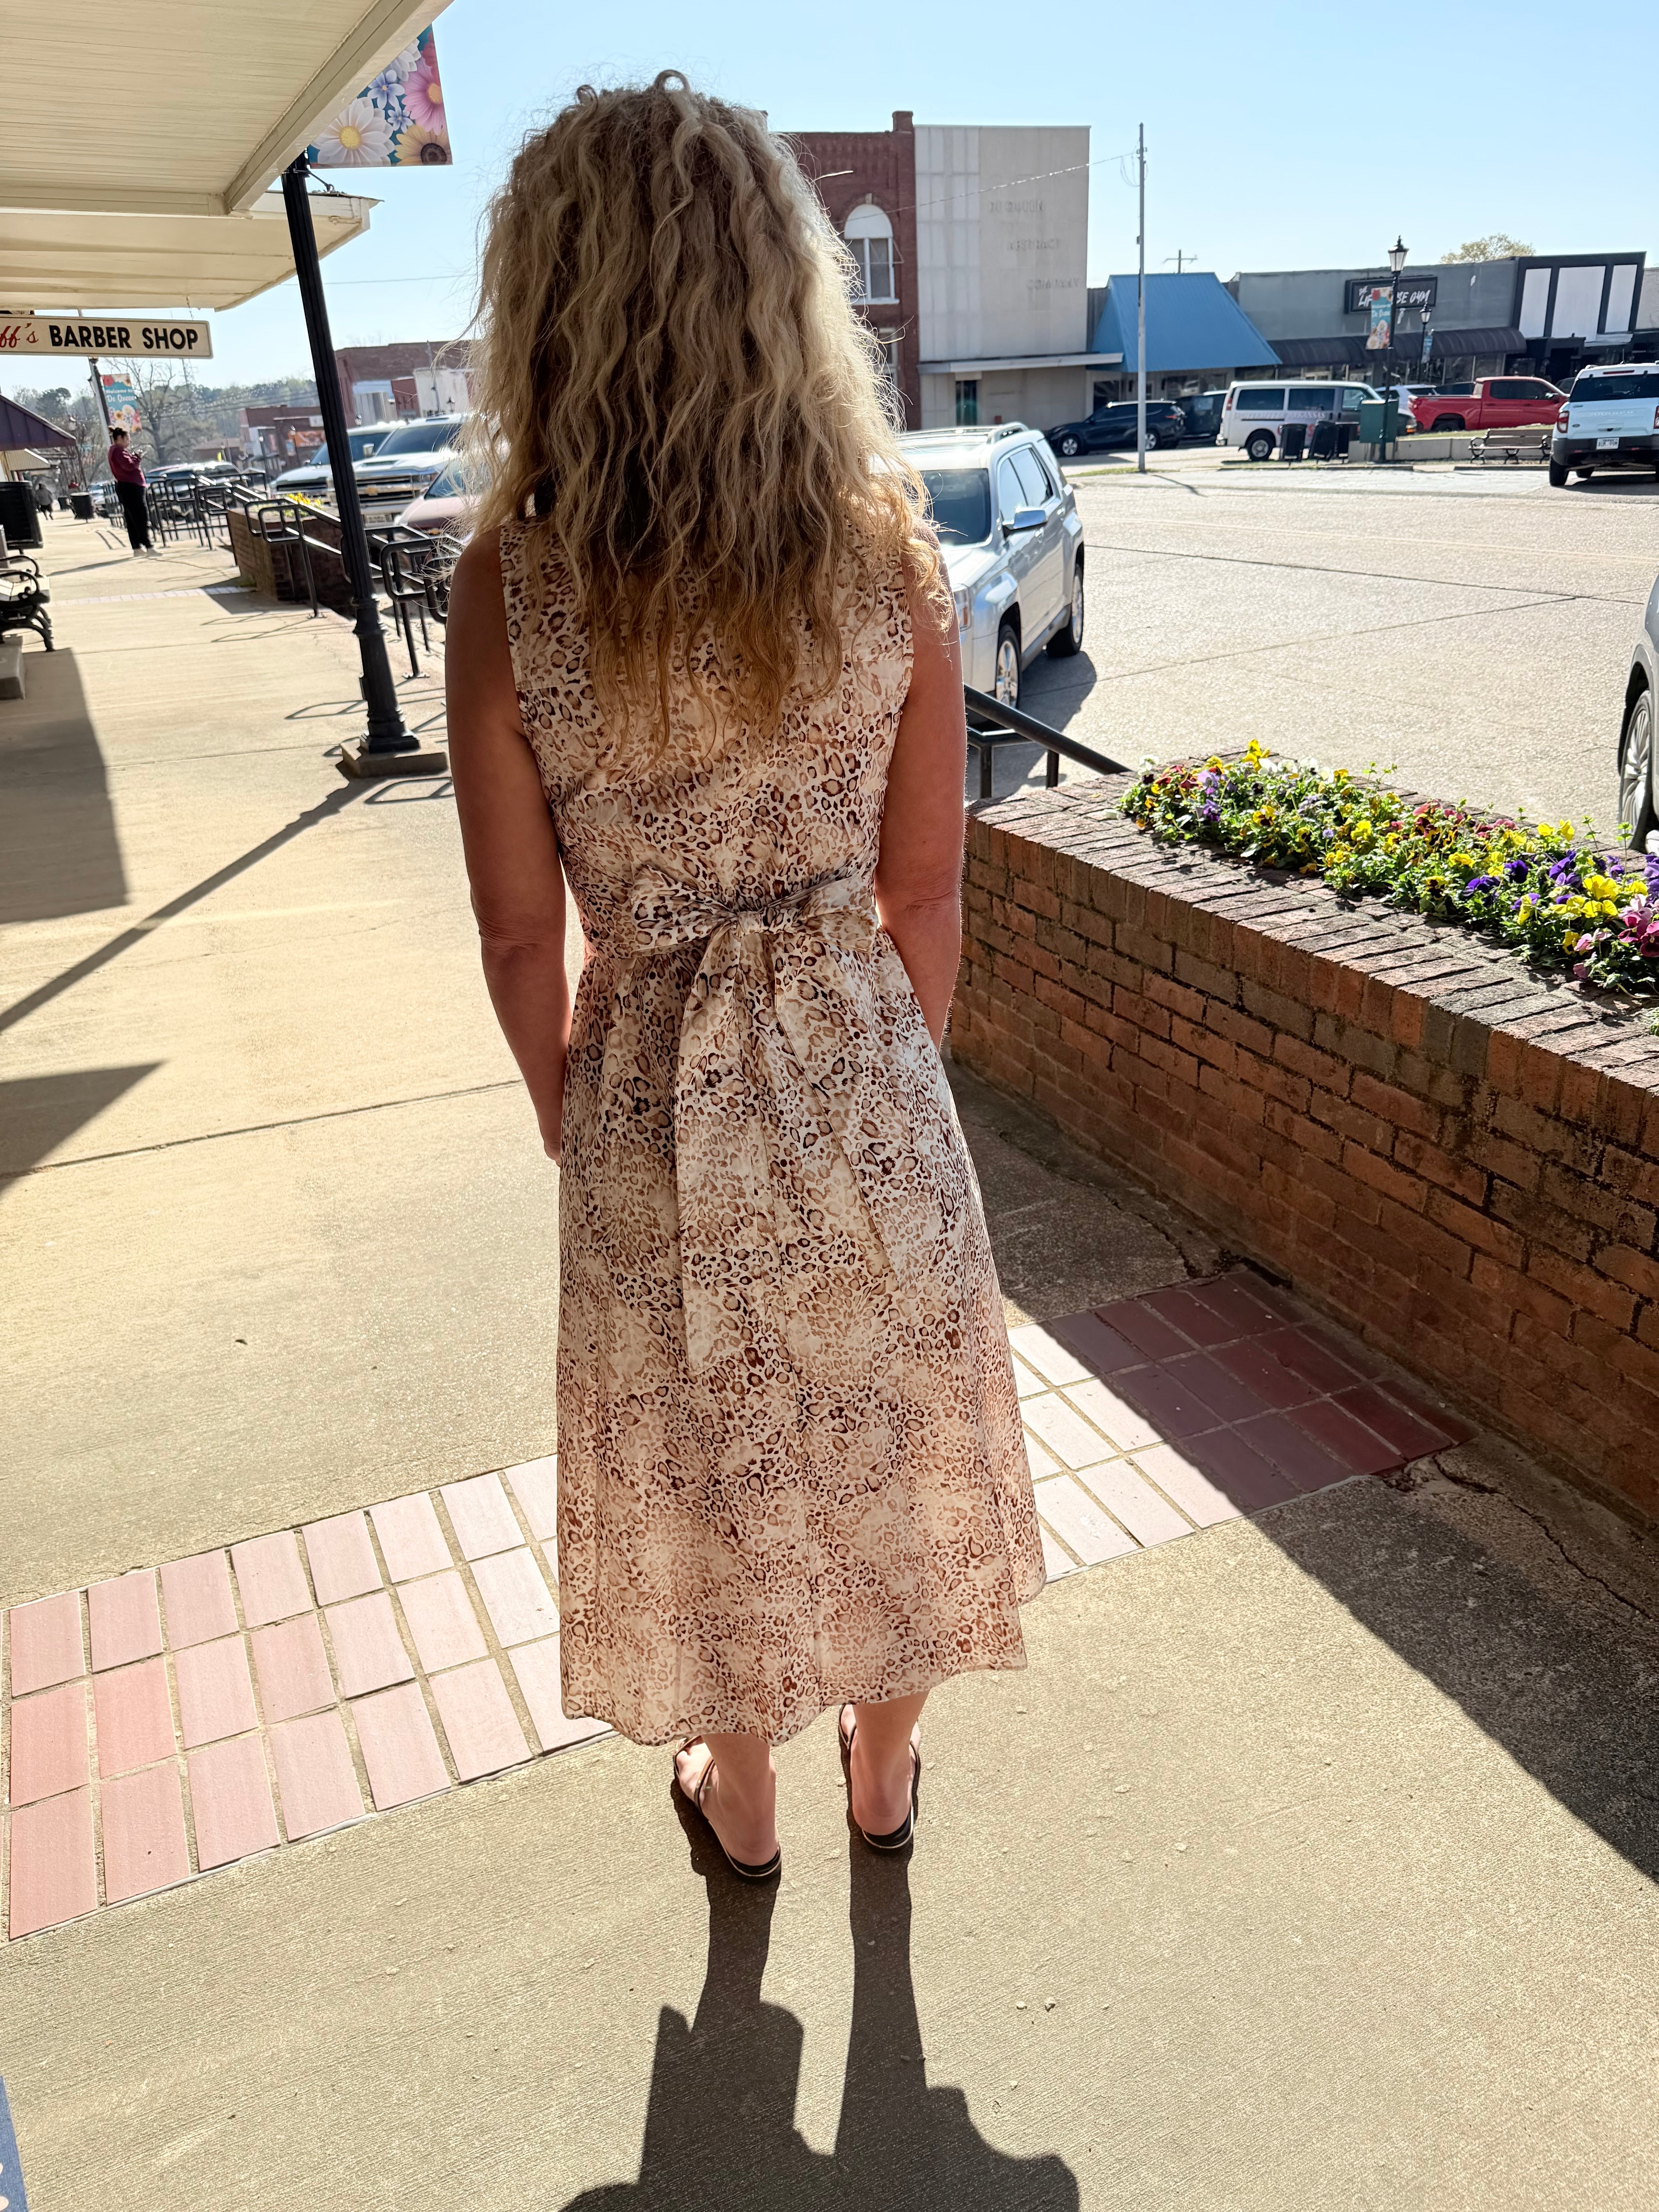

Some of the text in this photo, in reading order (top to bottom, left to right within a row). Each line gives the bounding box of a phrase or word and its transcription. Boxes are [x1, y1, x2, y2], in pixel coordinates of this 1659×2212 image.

[1410, 290, 1431, 304] GYM
[49, 325, 132, 348] BARBER
[142, 327, 198, 350] SHOP
